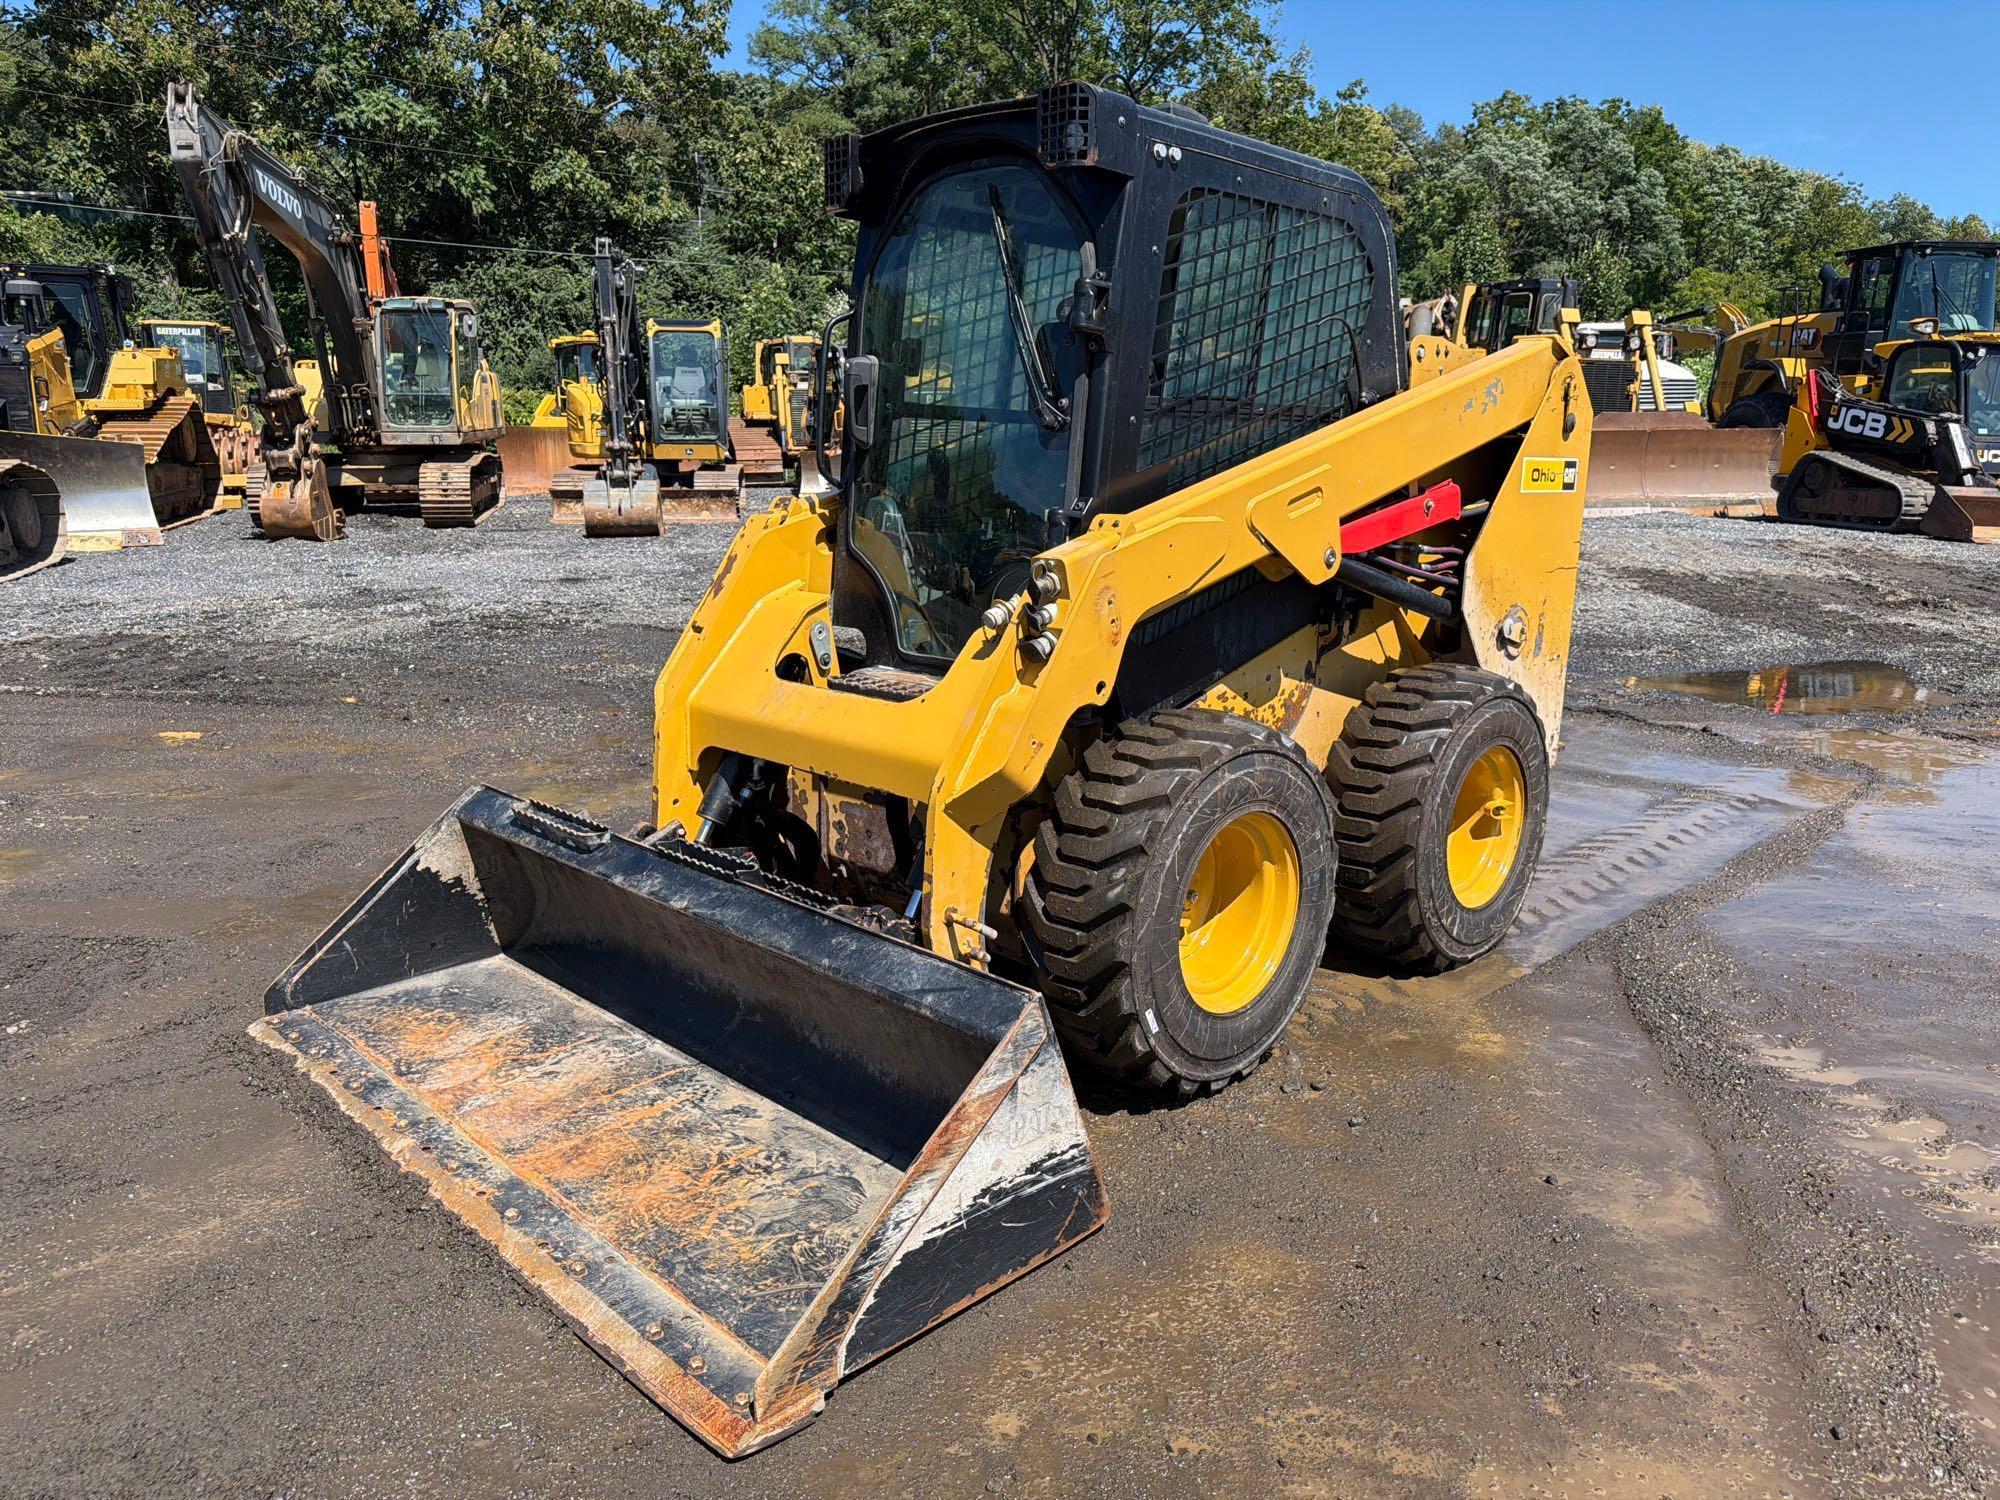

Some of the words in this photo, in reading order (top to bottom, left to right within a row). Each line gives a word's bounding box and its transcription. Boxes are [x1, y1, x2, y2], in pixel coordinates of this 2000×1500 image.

[256, 169, 302, 219] VOLVO
[156, 327, 201, 336] CATERPILLAR
[1827, 406, 1887, 438] JCB
[1531, 467, 1556, 482] Ohio
